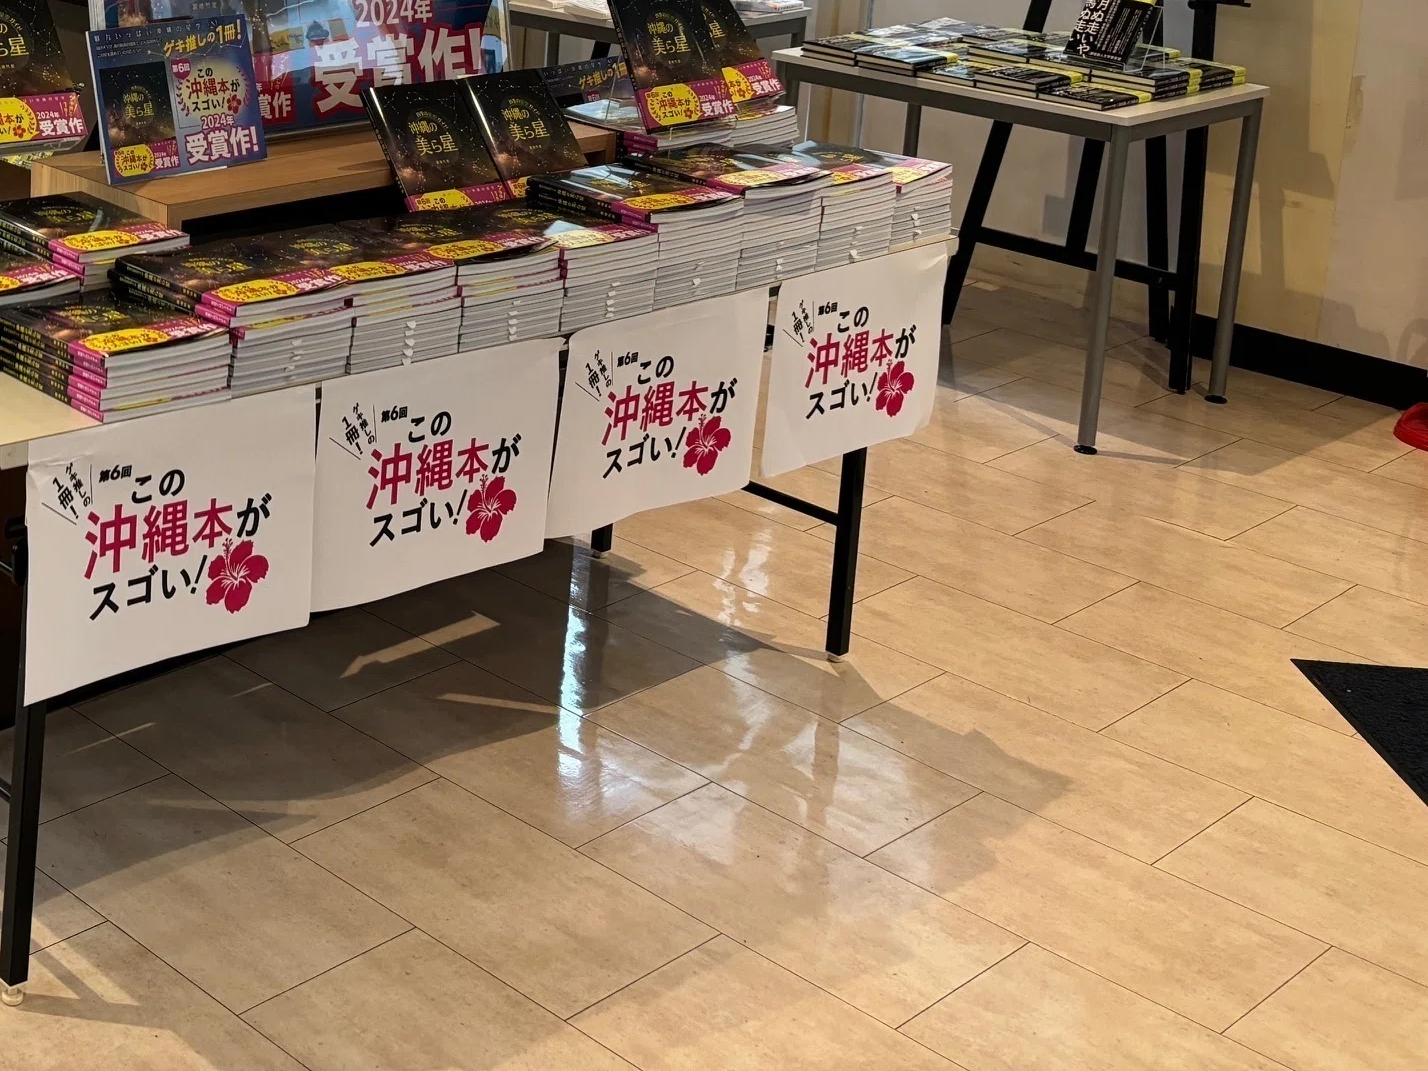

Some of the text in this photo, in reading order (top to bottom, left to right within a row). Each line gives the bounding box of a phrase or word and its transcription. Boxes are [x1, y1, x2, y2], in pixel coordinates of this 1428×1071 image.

[164, 19, 242, 58] ゲキ推しの1冊!
[647, 21, 674, 35] 沖縄の
[652, 35, 691, 56] 美ら星
[172, 62, 190, 73] 第6回
[197, 68, 213, 78] この
[314, 27, 484, 114] 受賞作!
[186, 77, 240, 100] 沖縄本が
[752, 78, 782, 96] 受賞作
[37, 111, 59, 120] 2024年
[192, 100, 225, 113] スゴい!
[502, 108, 530, 122] 沖縄の
[657, 97, 691, 111] 沖縄本が
[701, 101, 734, 117] 受賞作
[39, 118, 84, 136] 受賞作
[201, 114, 234, 129] 2024年
[407, 120, 438, 135] 沖縄の
[509, 119, 550, 141] 美ら星
[185, 125, 259, 166] 受賞作!
[414, 133, 459, 157] 美ら星
[155, 156, 180, 170] 受賞作
[818, 301, 870, 333] 第6回 この
[617, 351, 674, 386] 第6回 この
[804, 324, 917, 390] 沖縄本が
[806, 372, 878, 420] スゴい!
[601, 377, 738, 446] 沖縄本が
[380, 406, 452, 445] 第6回 この
[602, 426, 686, 480] スゴい!
[366, 433, 522, 511] 沖縄本が
[98, 464, 185, 504] 第6回 この
[370, 489, 468, 548] スゴい!
[84, 493, 272, 580] 沖縄本が
[89, 554, 208, 621] スゴい!
